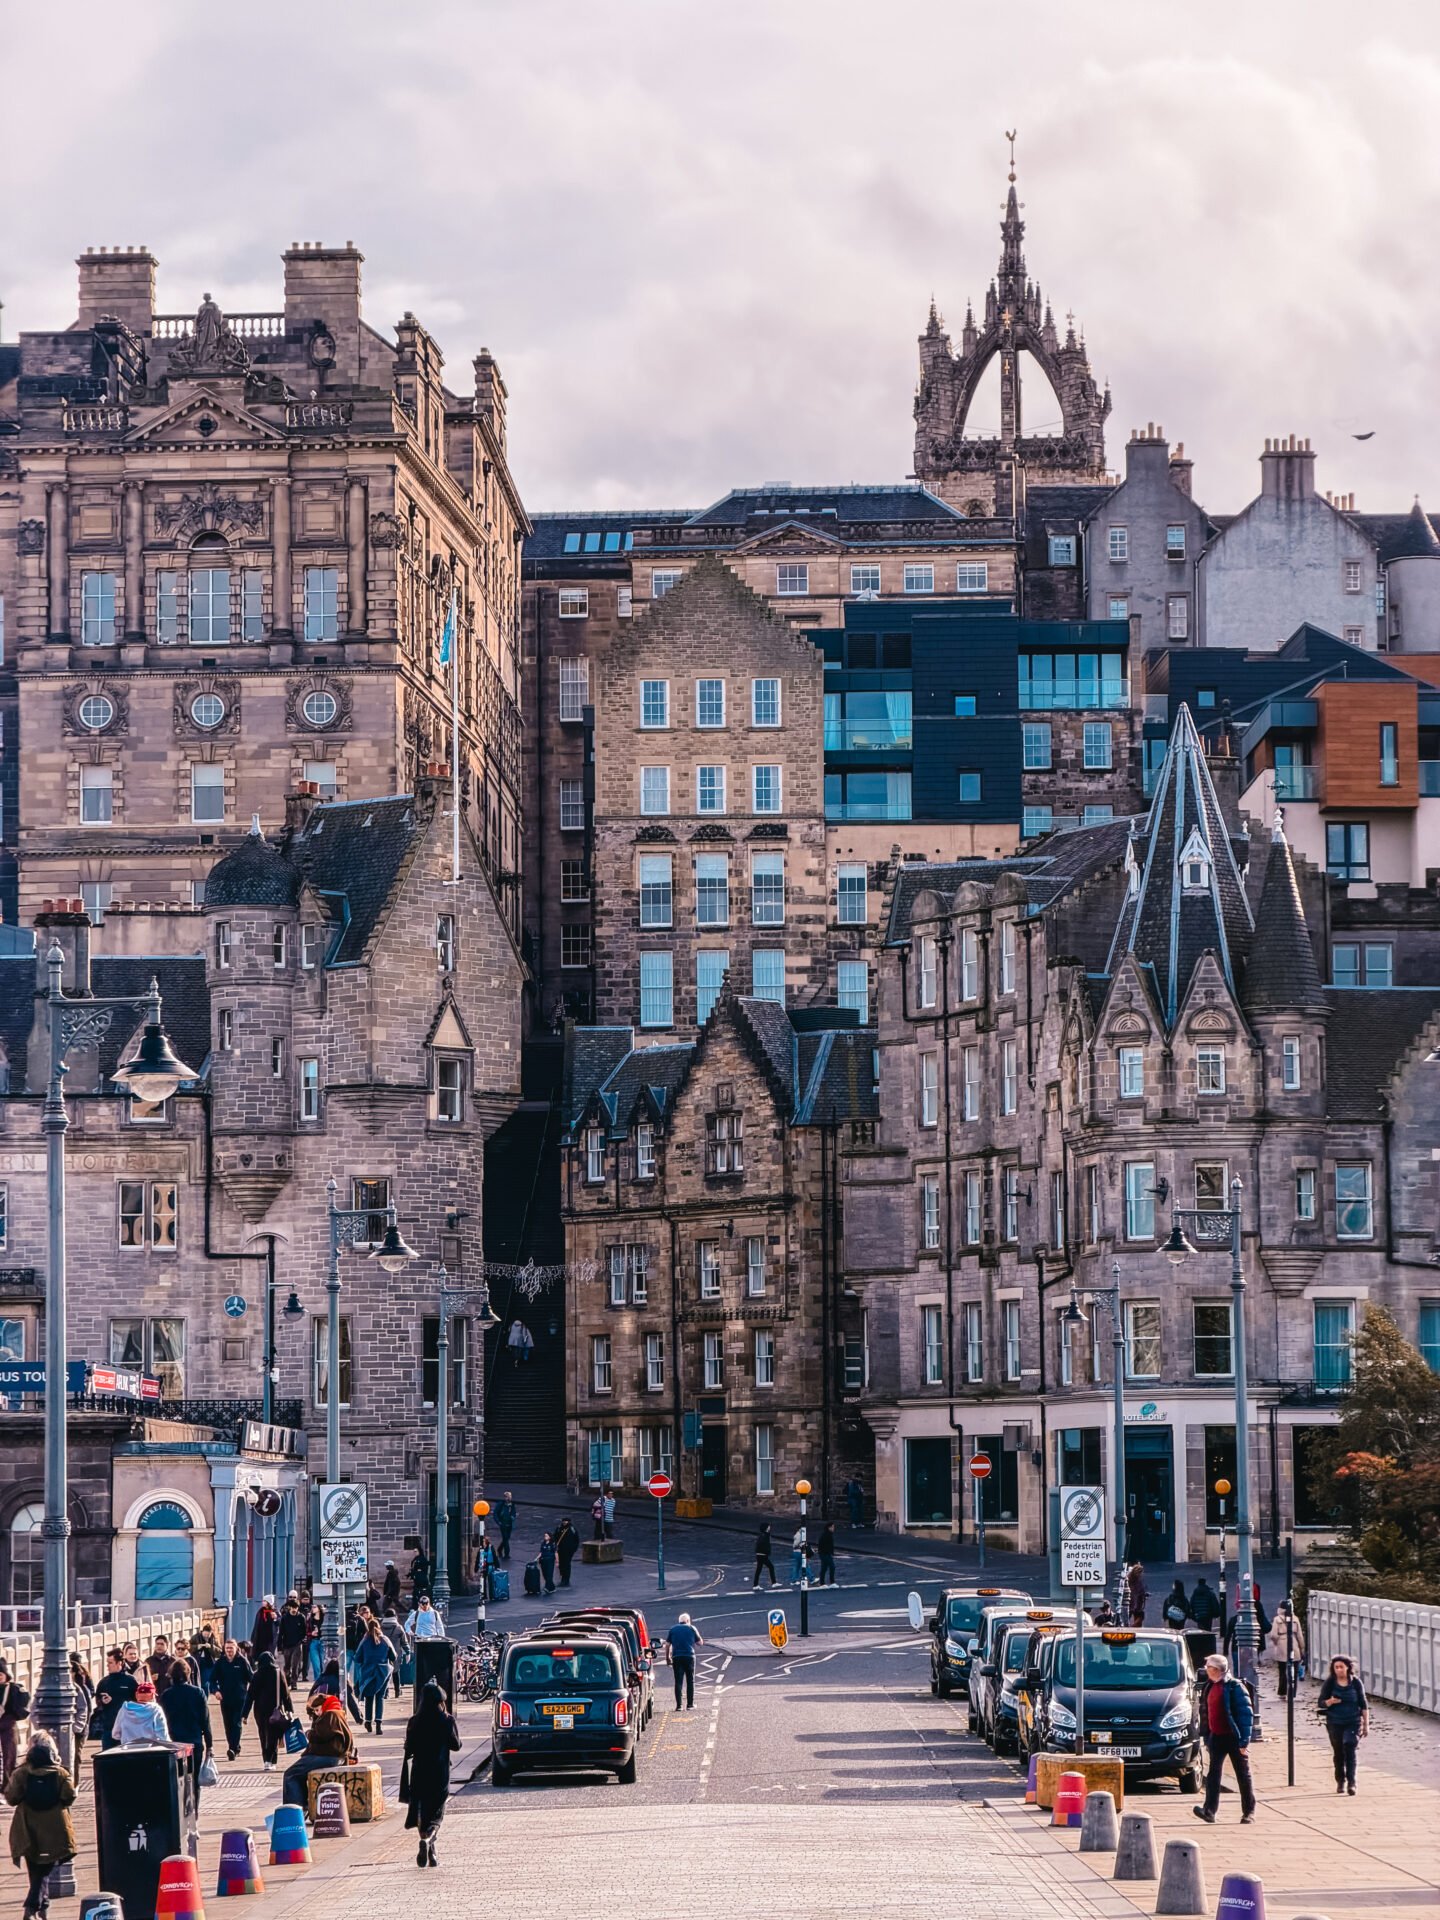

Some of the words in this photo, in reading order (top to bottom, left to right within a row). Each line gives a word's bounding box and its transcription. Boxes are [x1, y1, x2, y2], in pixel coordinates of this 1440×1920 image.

[0, 1371, 20, 1382] US
[140, 1503, 162, 1524] TICKET
[1063, 1542, 1103, 1550] Pedestrian
[1066, 1551, 1080, 1559] and
[1081, 1551, 1100, 1560] cycle
[1074, 1560, 1093, 1568] Zone
[1066, 1570, 1100, 1581] ENDS
[948, 1657, 966, 1666] TAXI
[1050, 1727, 1077, 1741] TAXI
[1161, 1728, 1189, 1741] TAXI
[1100, 1748, 1121, 1756] SF68
[1122, 1748, 1138, 1756] HVN
